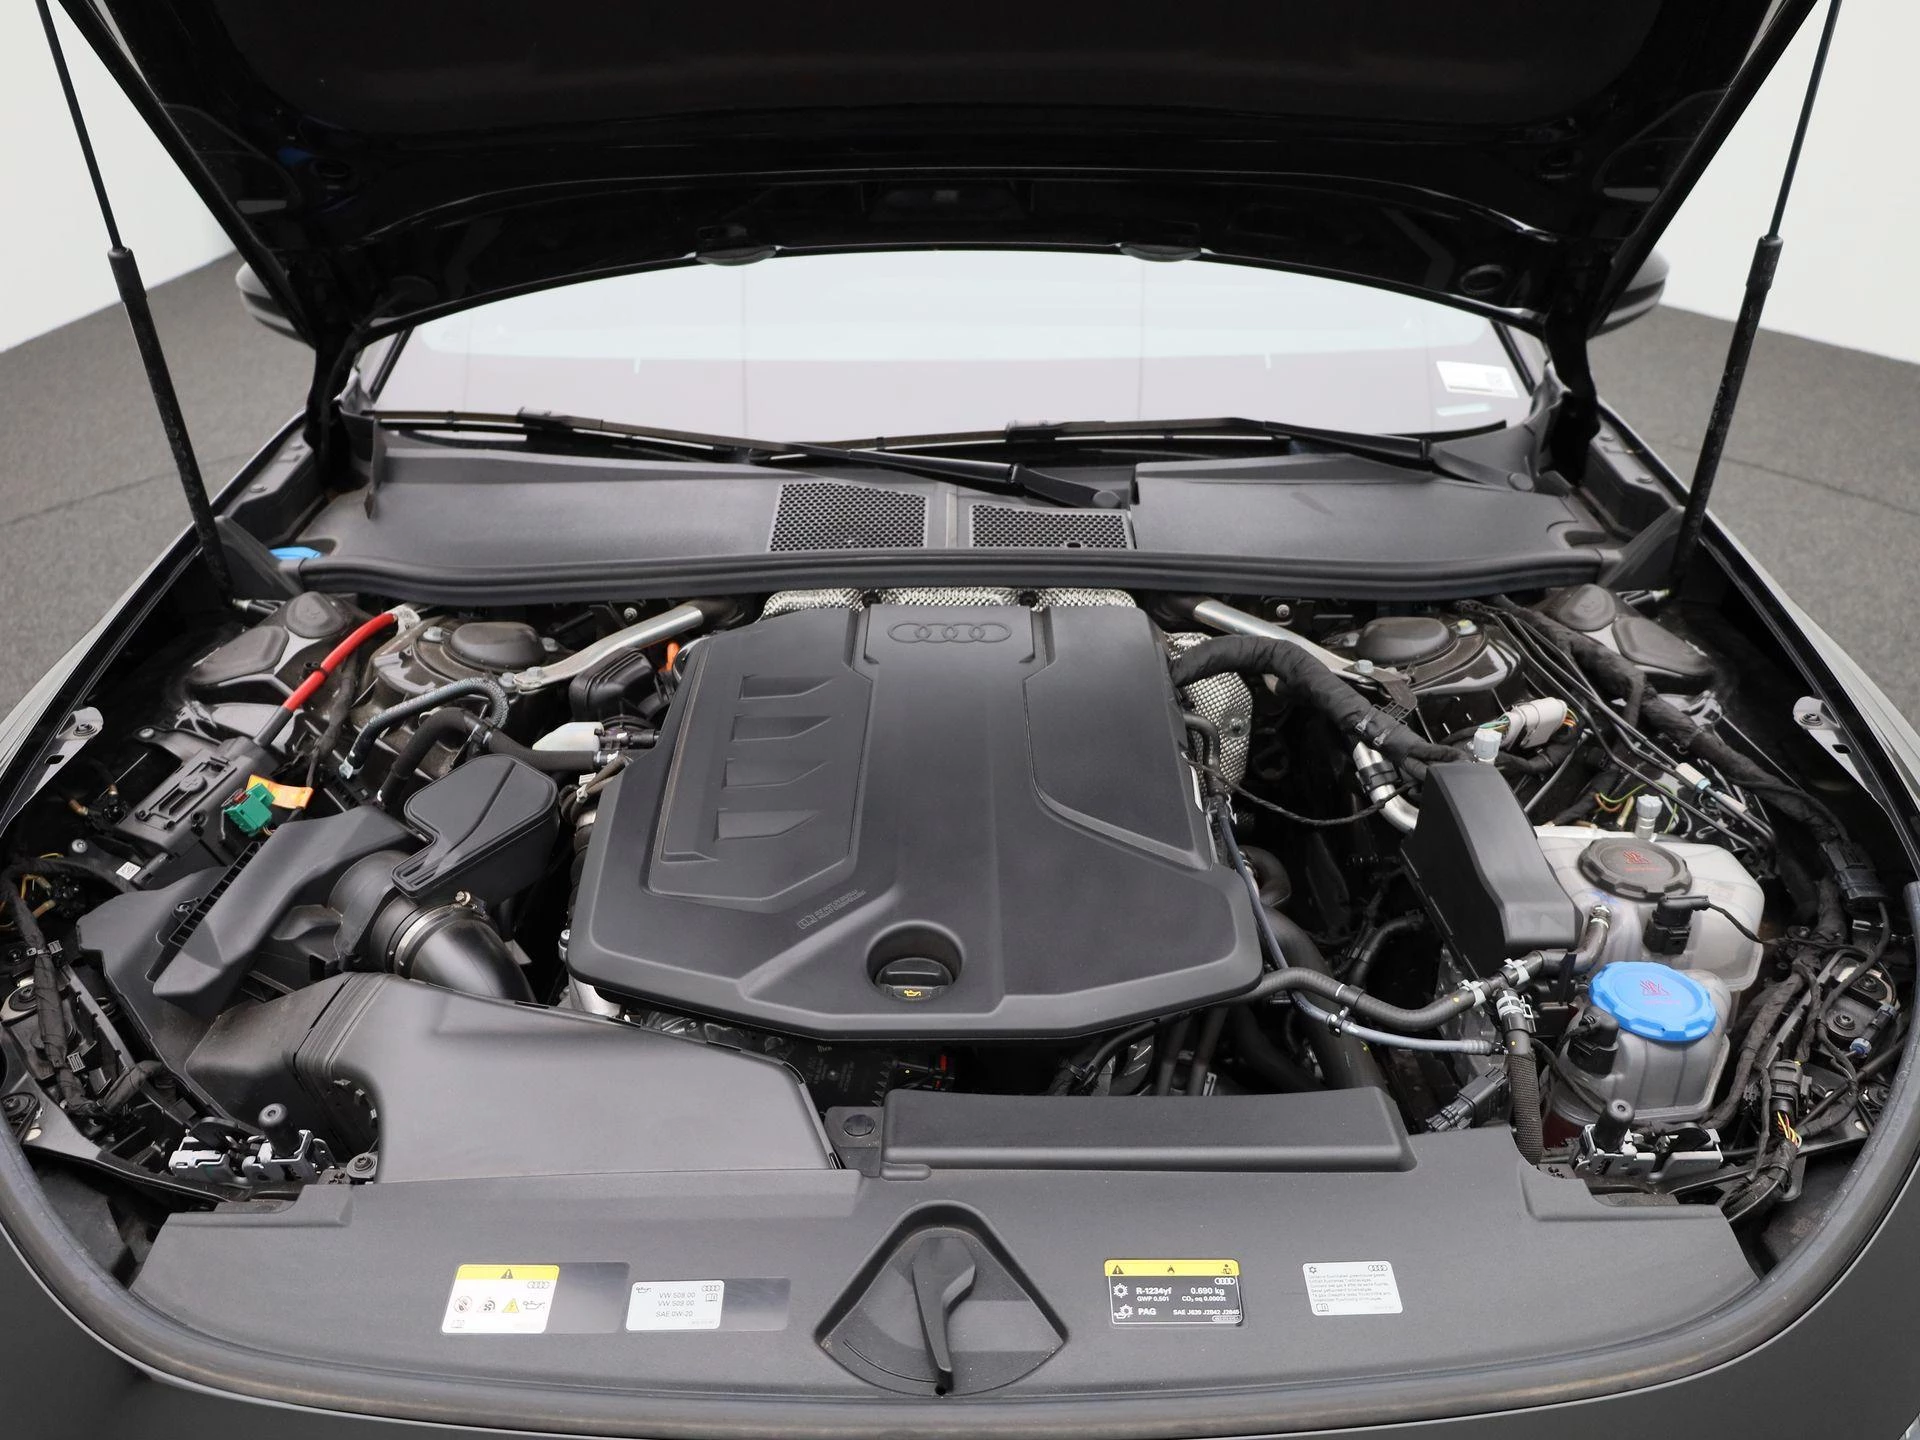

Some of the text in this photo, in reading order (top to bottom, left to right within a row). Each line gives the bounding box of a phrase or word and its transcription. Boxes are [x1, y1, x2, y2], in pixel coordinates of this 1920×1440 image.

[1136, 1287, 1172, 1296] R-1234yf
[1190, 1287, 1225, 1296] 0.690 kg
[1138, 1308, 1157, 1316] PAG
